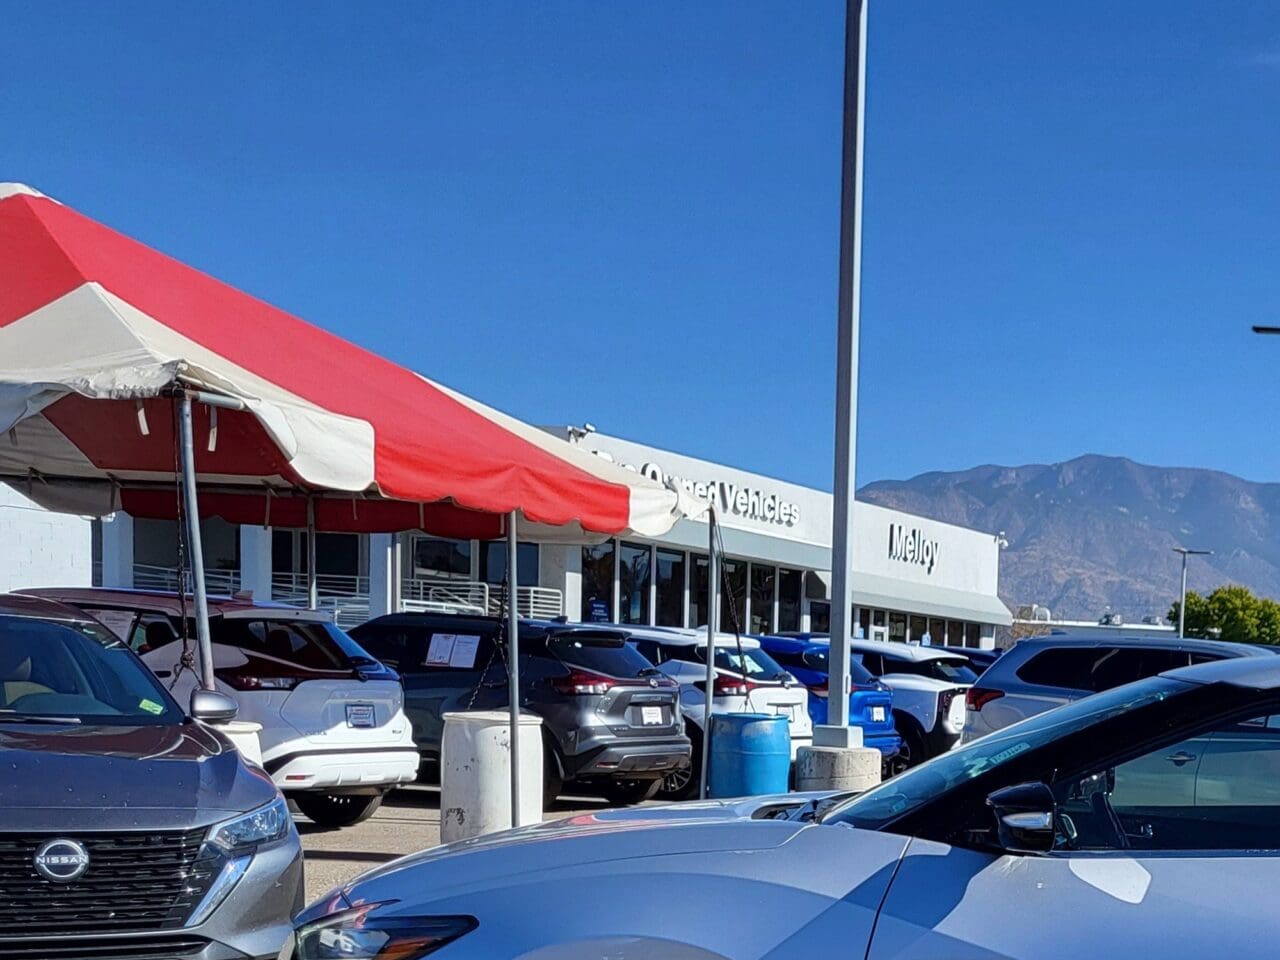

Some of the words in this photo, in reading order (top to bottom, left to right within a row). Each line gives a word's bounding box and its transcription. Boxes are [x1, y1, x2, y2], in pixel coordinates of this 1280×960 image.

[722, 480, 800, 527] Vehicles
[888, 523, 940, 575] Melloy
[36, 855, 89, 865] NISSAN
